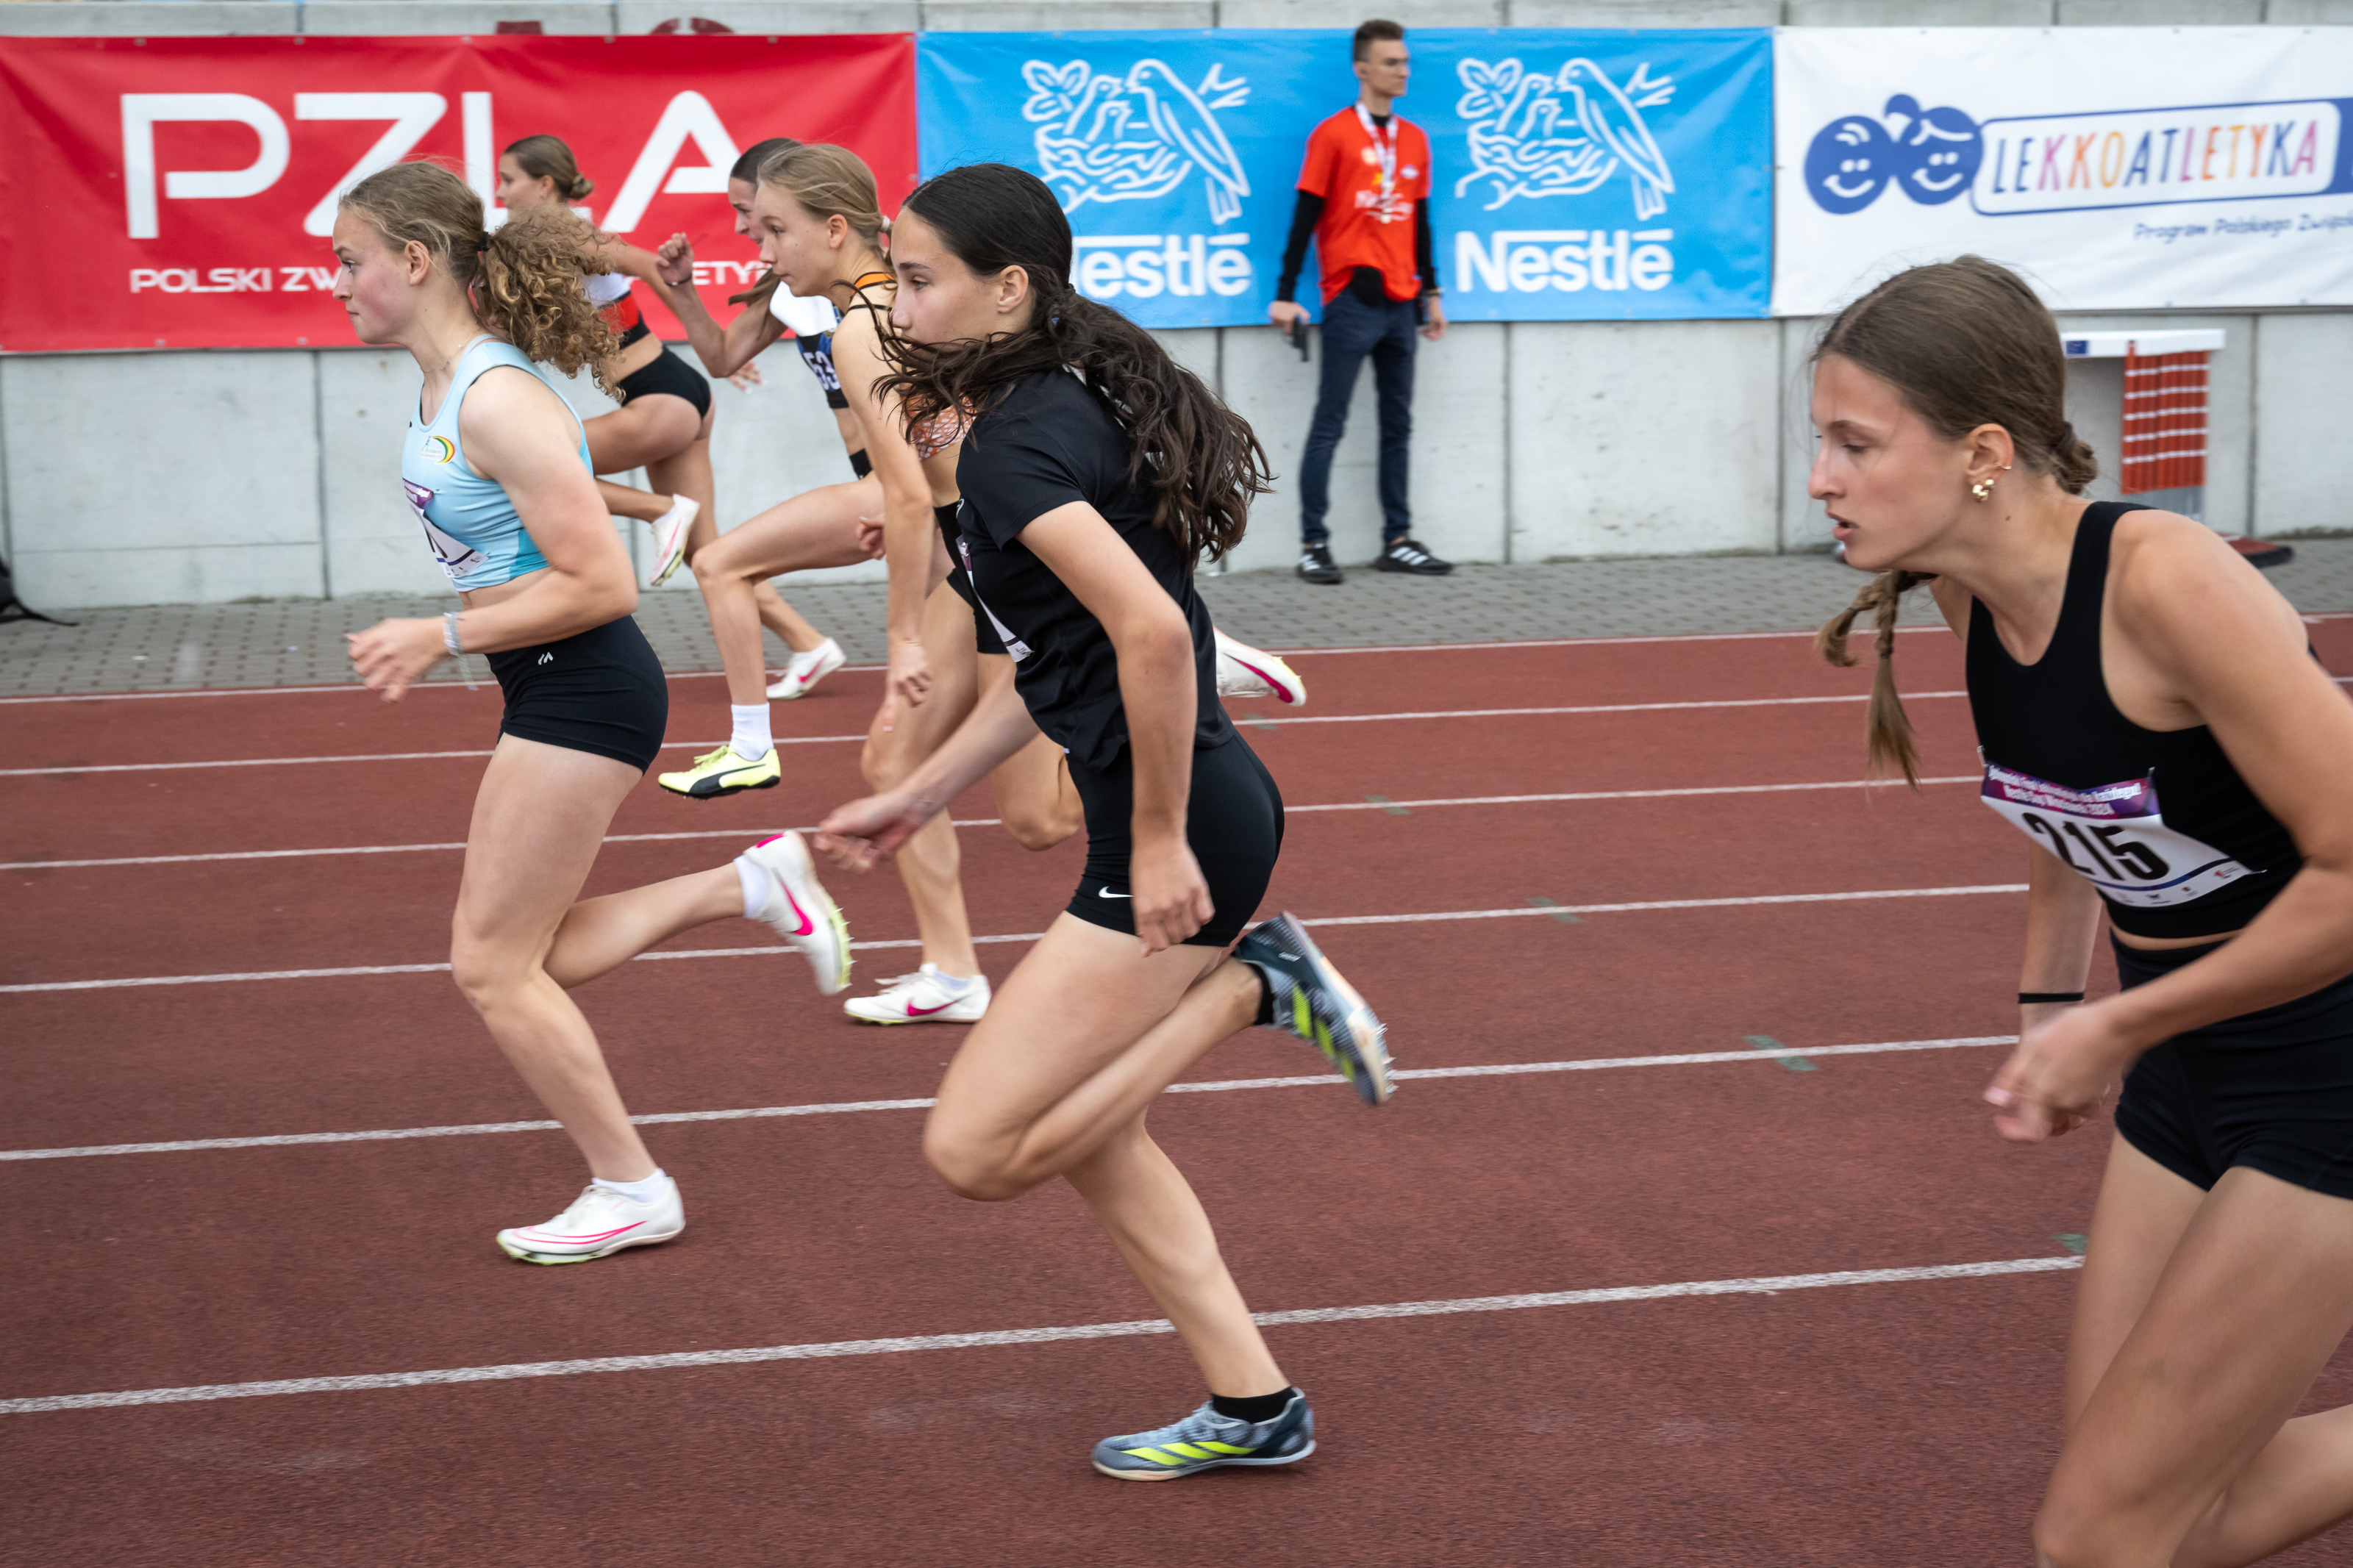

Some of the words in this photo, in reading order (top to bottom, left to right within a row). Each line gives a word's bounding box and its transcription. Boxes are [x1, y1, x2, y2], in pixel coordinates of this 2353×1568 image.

[121, 90, 740, 239] PZLA
[1991, 121, 2318, 194] LEKKOATLETYKA
[129, 268, 272, 293] POLSKI
[1455, 229, 1674, 293] Nestlé
[2022, 812, 2170, 881] 215
